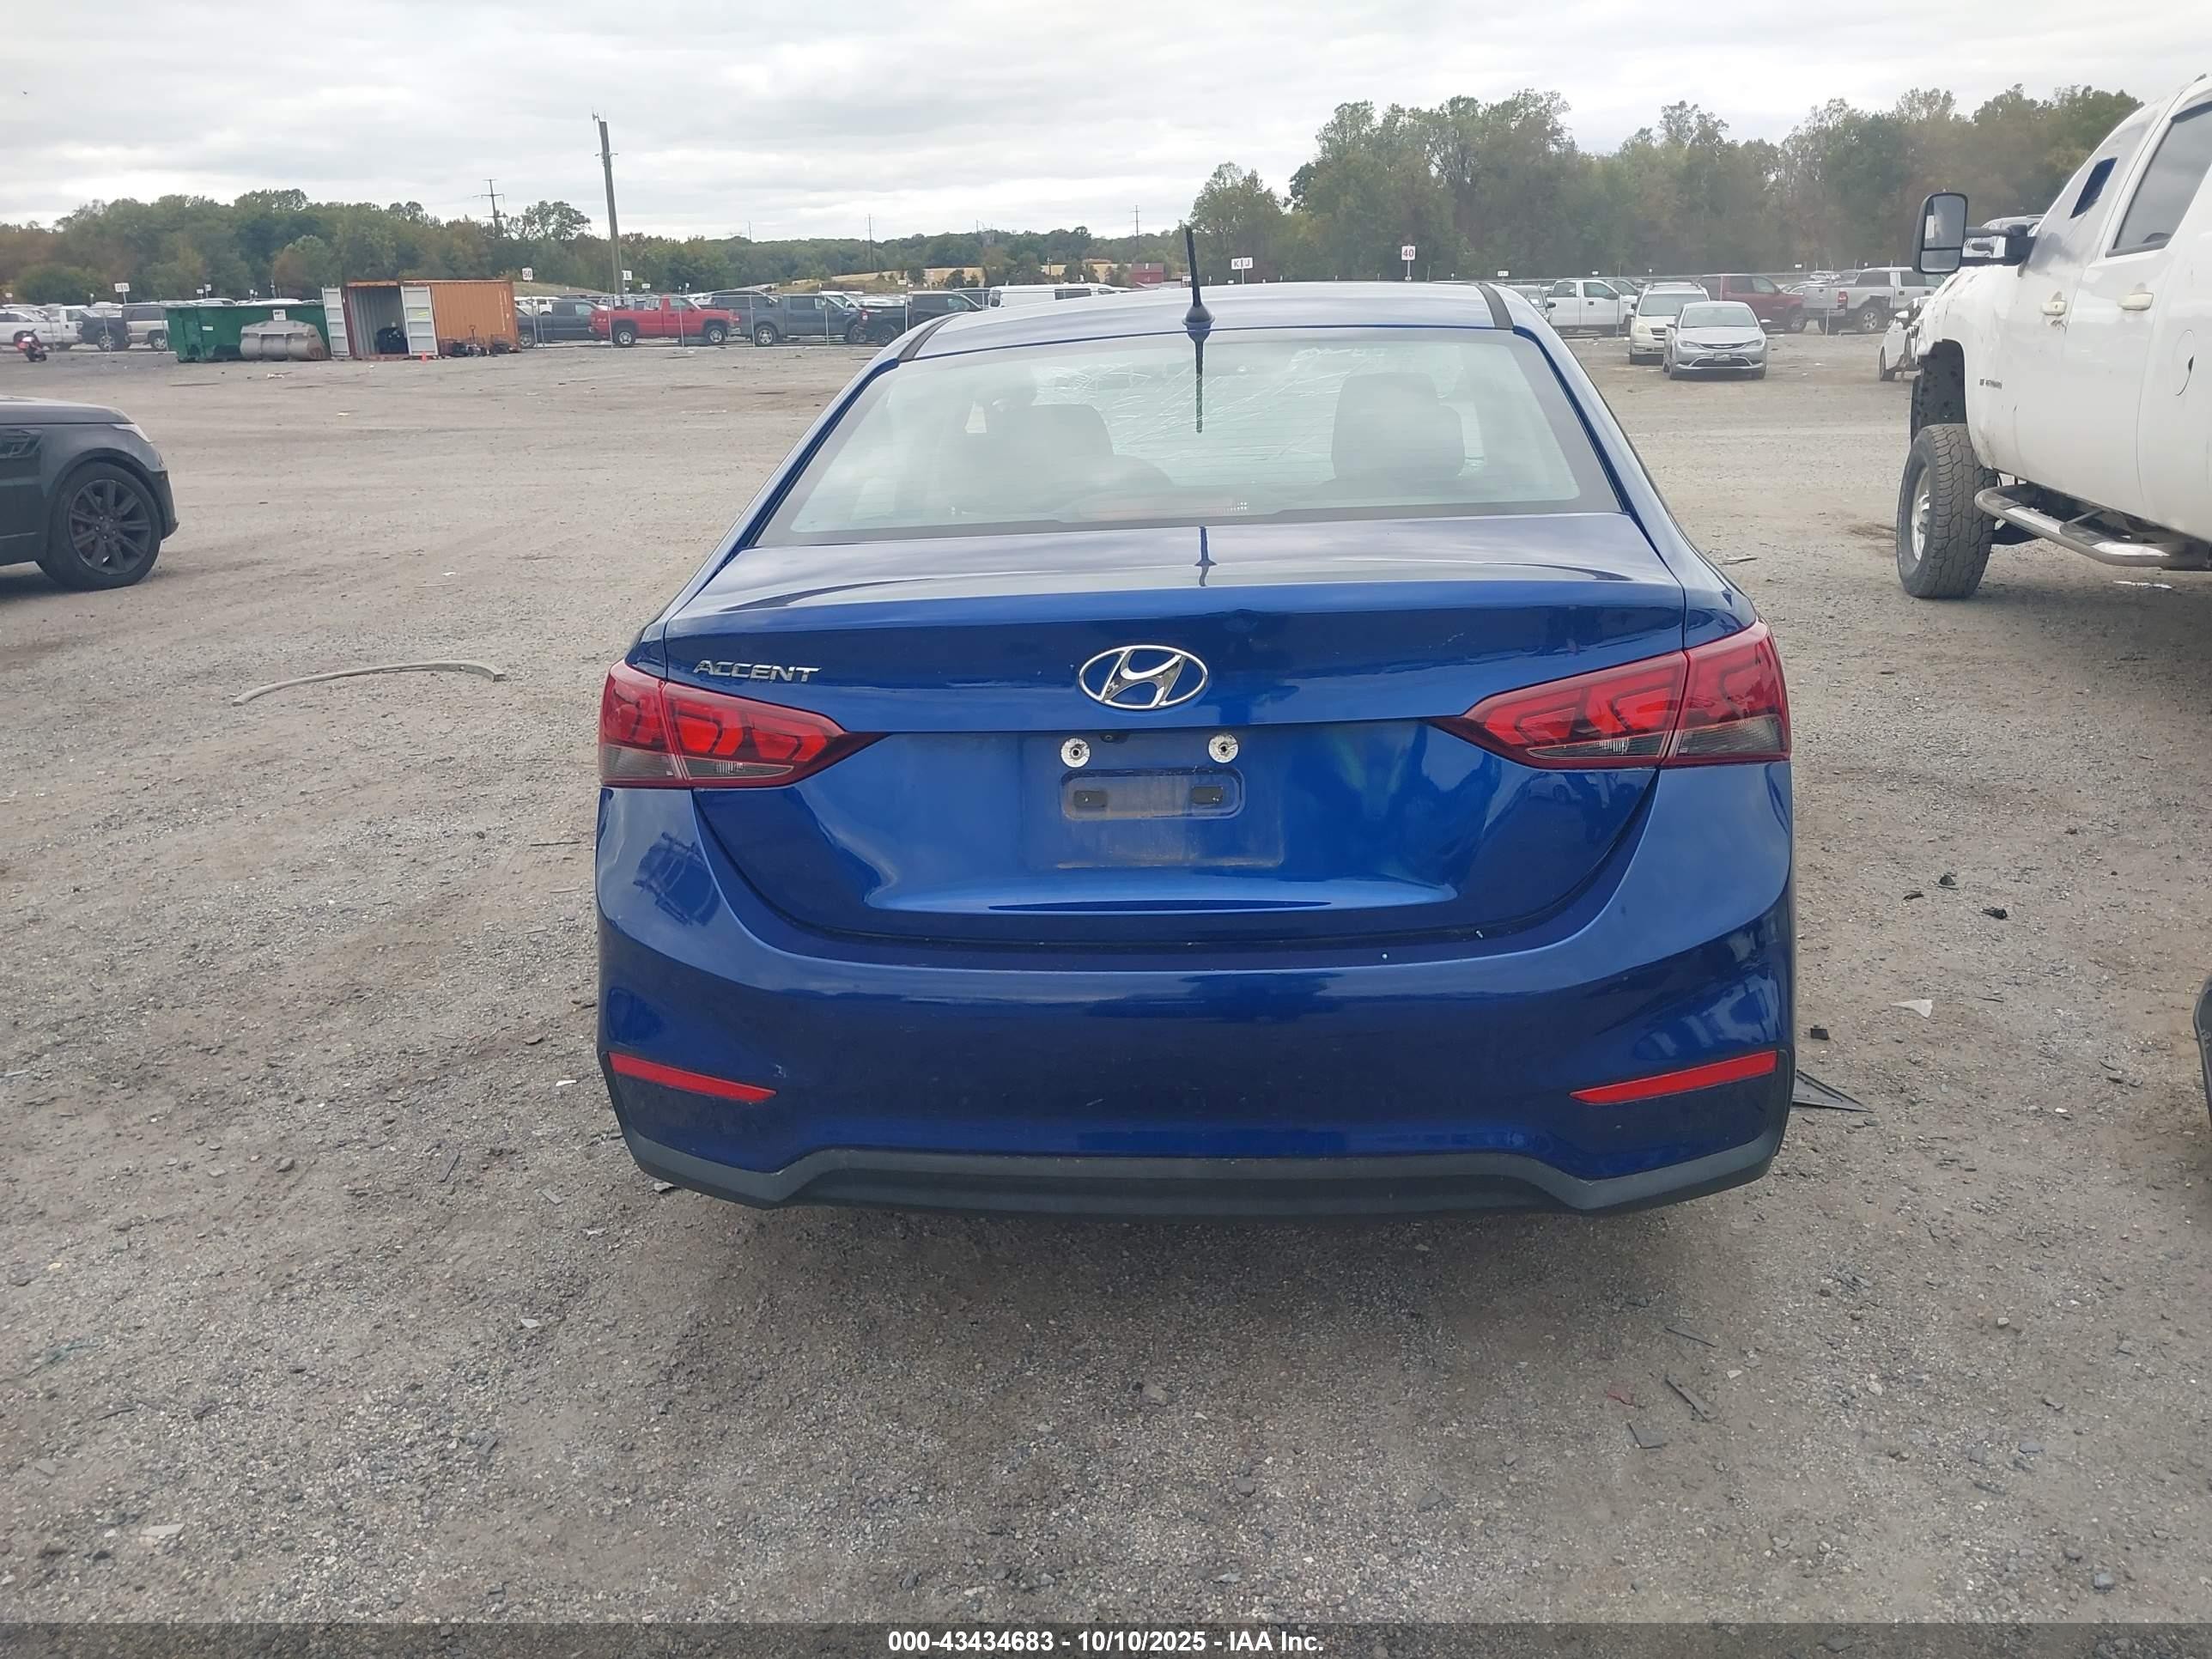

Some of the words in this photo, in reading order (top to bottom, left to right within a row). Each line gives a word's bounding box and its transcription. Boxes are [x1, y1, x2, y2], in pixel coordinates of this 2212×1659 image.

[1402, 248, 1414, 258] 40
[523, 270, 532, 278] 50
[693, 659, 823, 683] ACCENT
